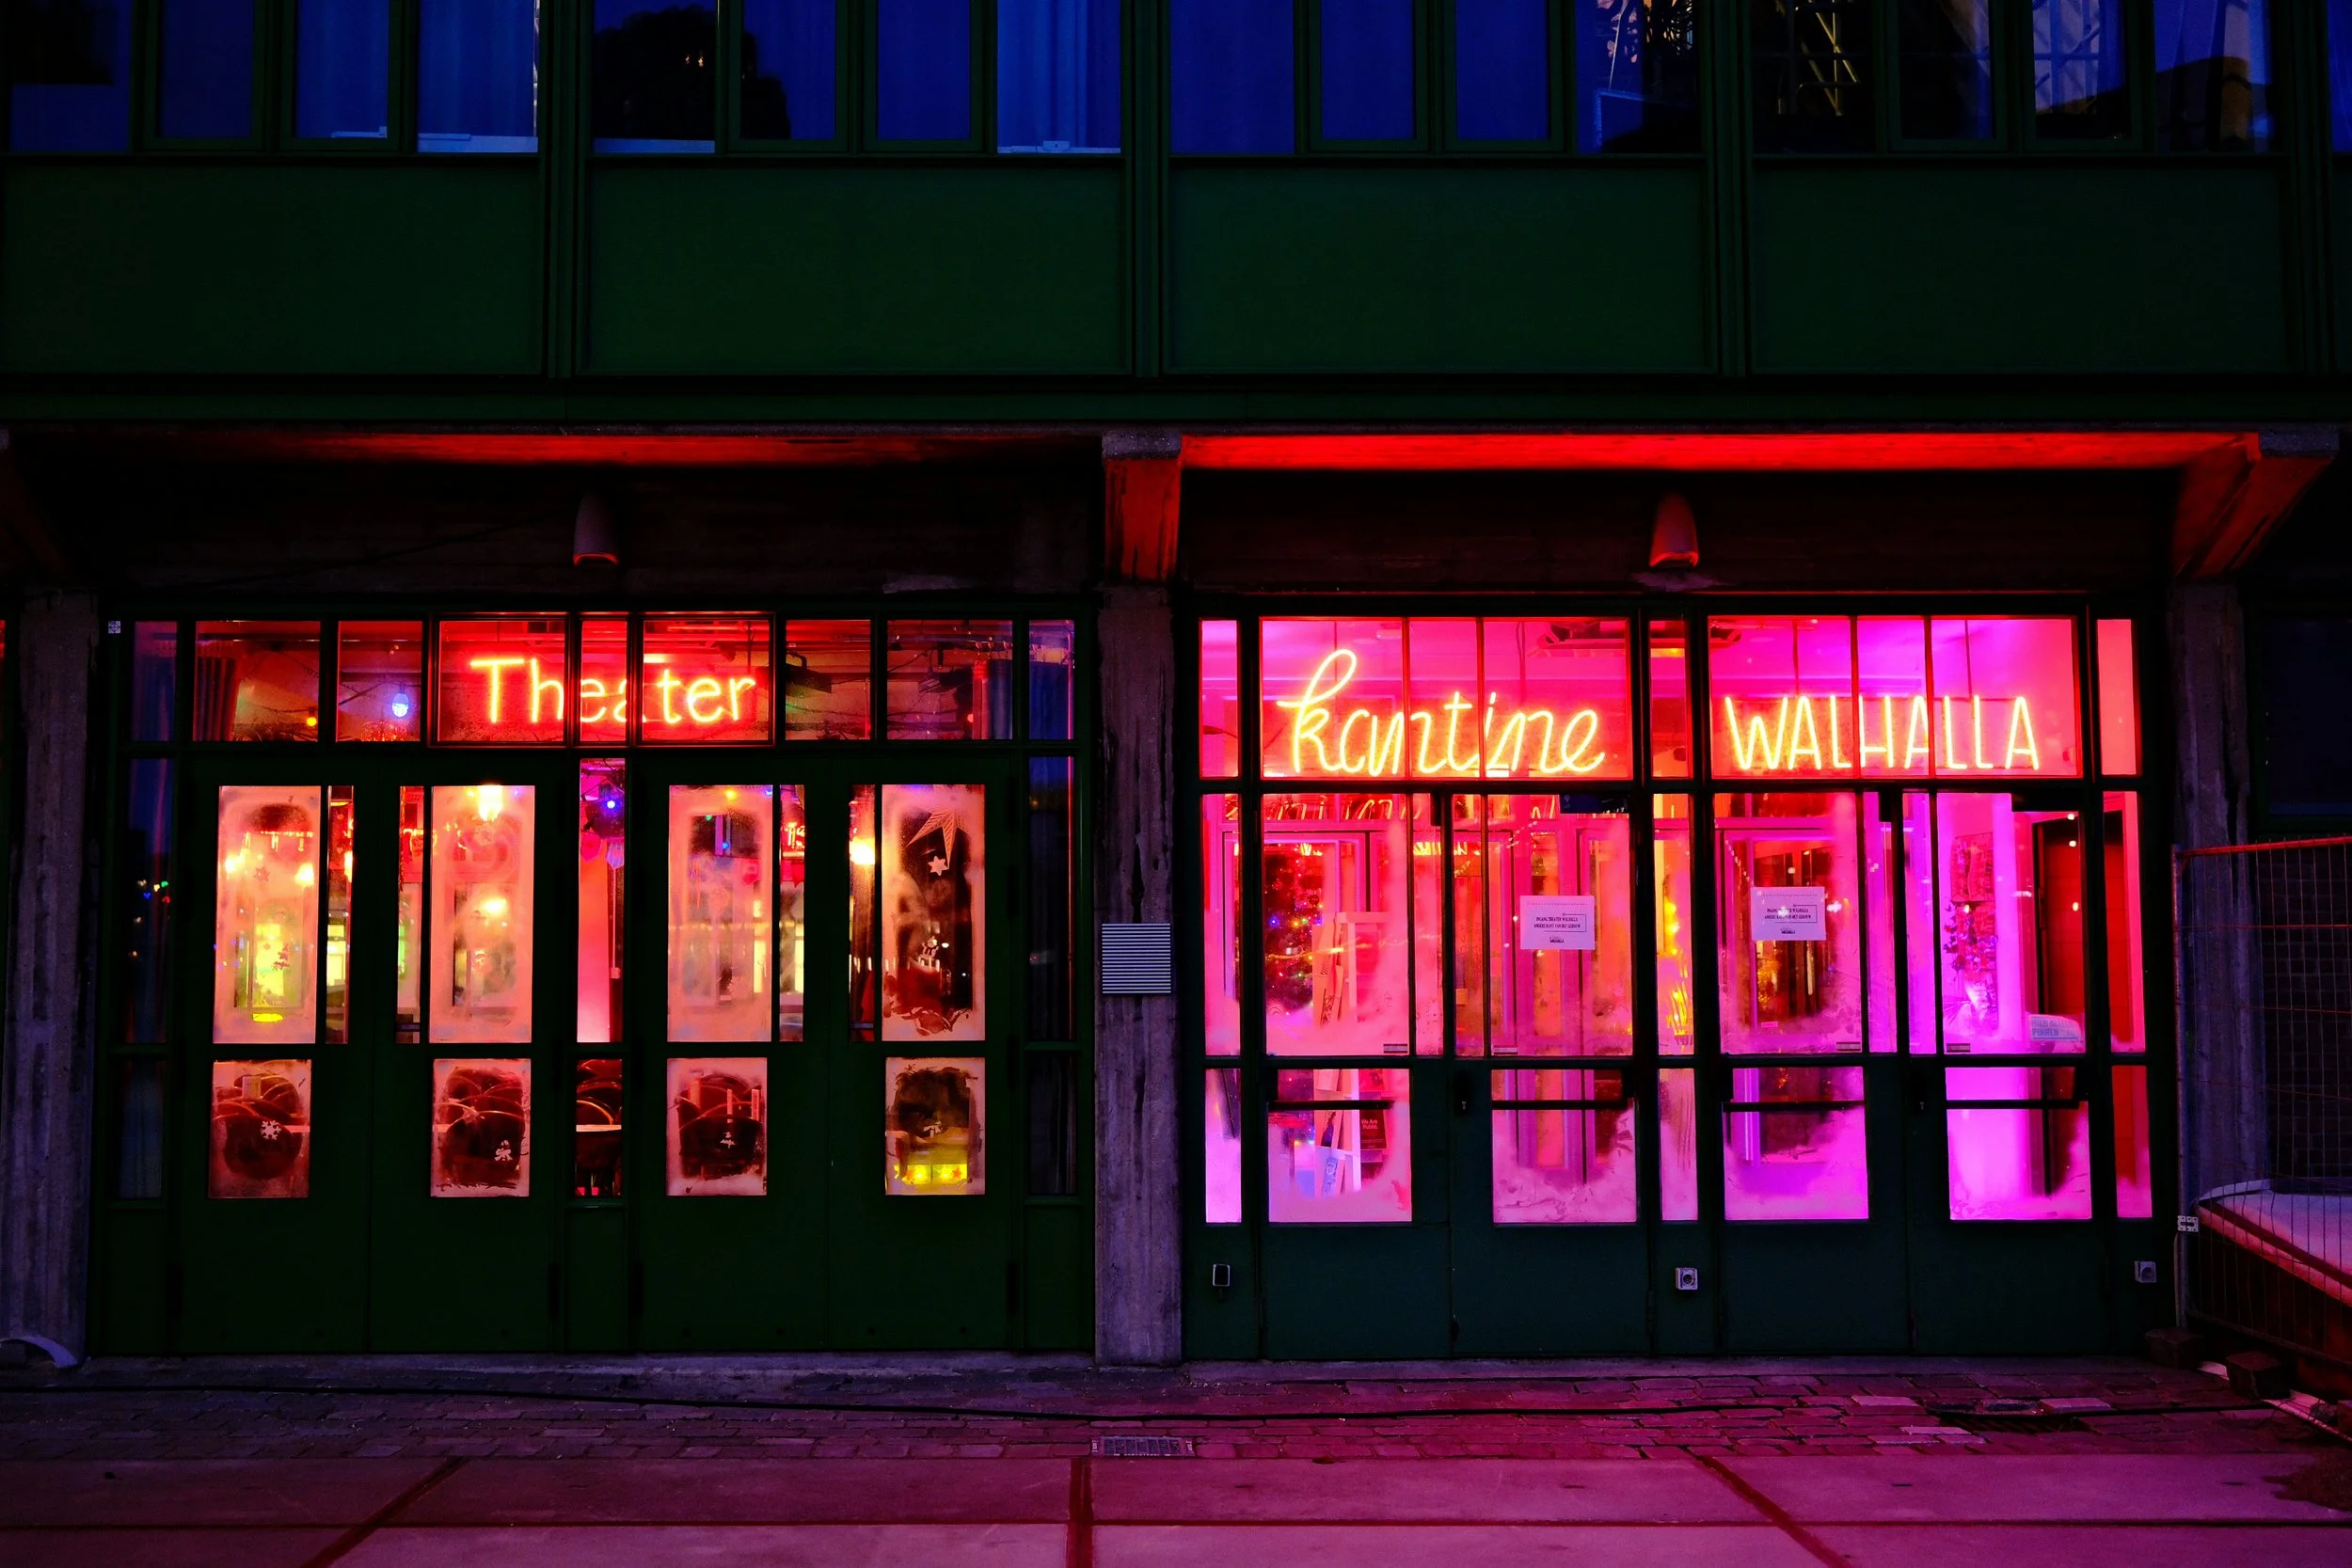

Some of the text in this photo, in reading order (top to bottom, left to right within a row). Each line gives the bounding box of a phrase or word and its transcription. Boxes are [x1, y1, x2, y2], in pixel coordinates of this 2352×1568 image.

[469, 657, 756, 723] Theater
[1277, 649, 2040, 776] kantine WALHALLA
